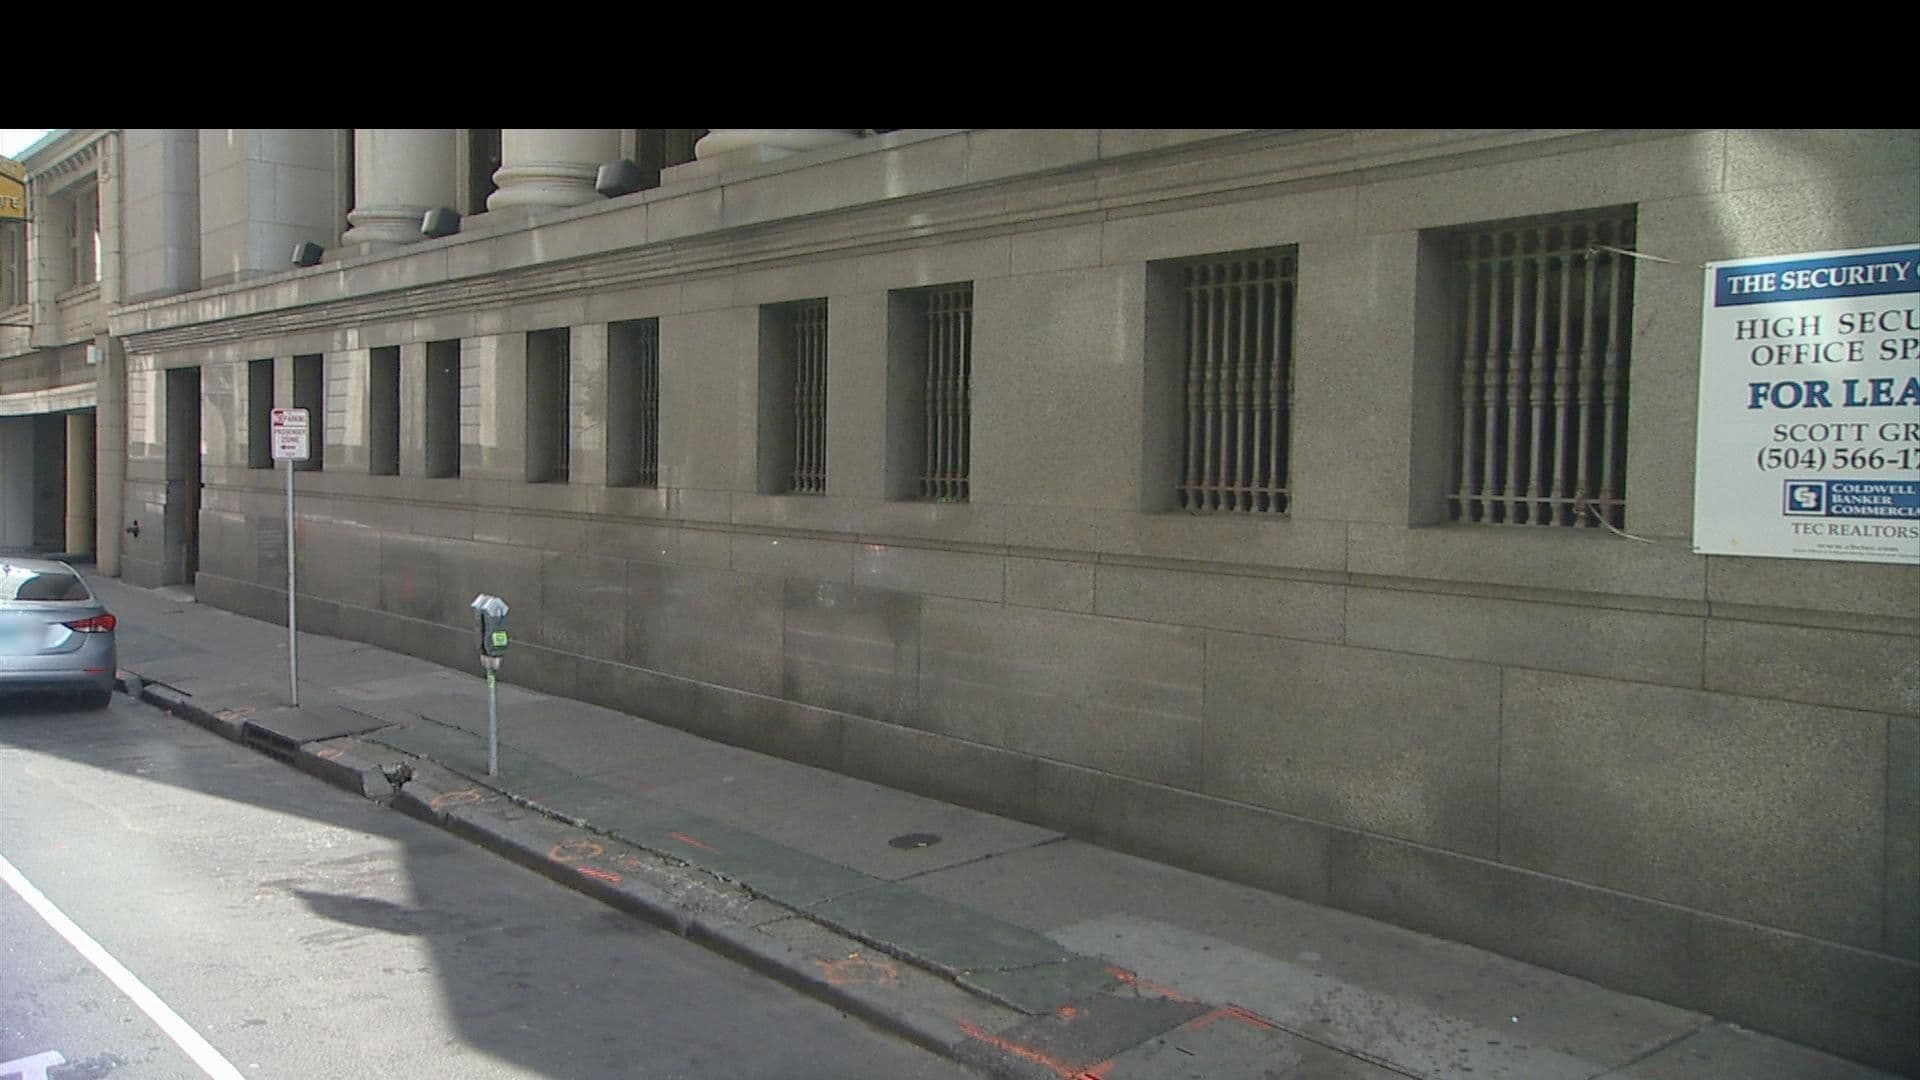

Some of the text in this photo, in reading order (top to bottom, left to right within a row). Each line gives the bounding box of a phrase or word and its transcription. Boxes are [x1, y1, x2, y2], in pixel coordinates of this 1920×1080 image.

[1728, 273, 1776, 295] THE
[1780, 261, 1911, 291] SECURITY
[1735, 314, 1822, 340] HIGH
[1750, 338, 1920, 367] OFFICE SP
[1747, 380, 1832, 409] FOR
[1772, 423, 1869, 442] SCOTT
[1757, 447, 1827, 472] (504)
[1831, 483, 1915, 495] COLDWELL
[1831, 494, 1893, 505] BANKER
[1792, 522, 1919, 539] TEC REALTORS
